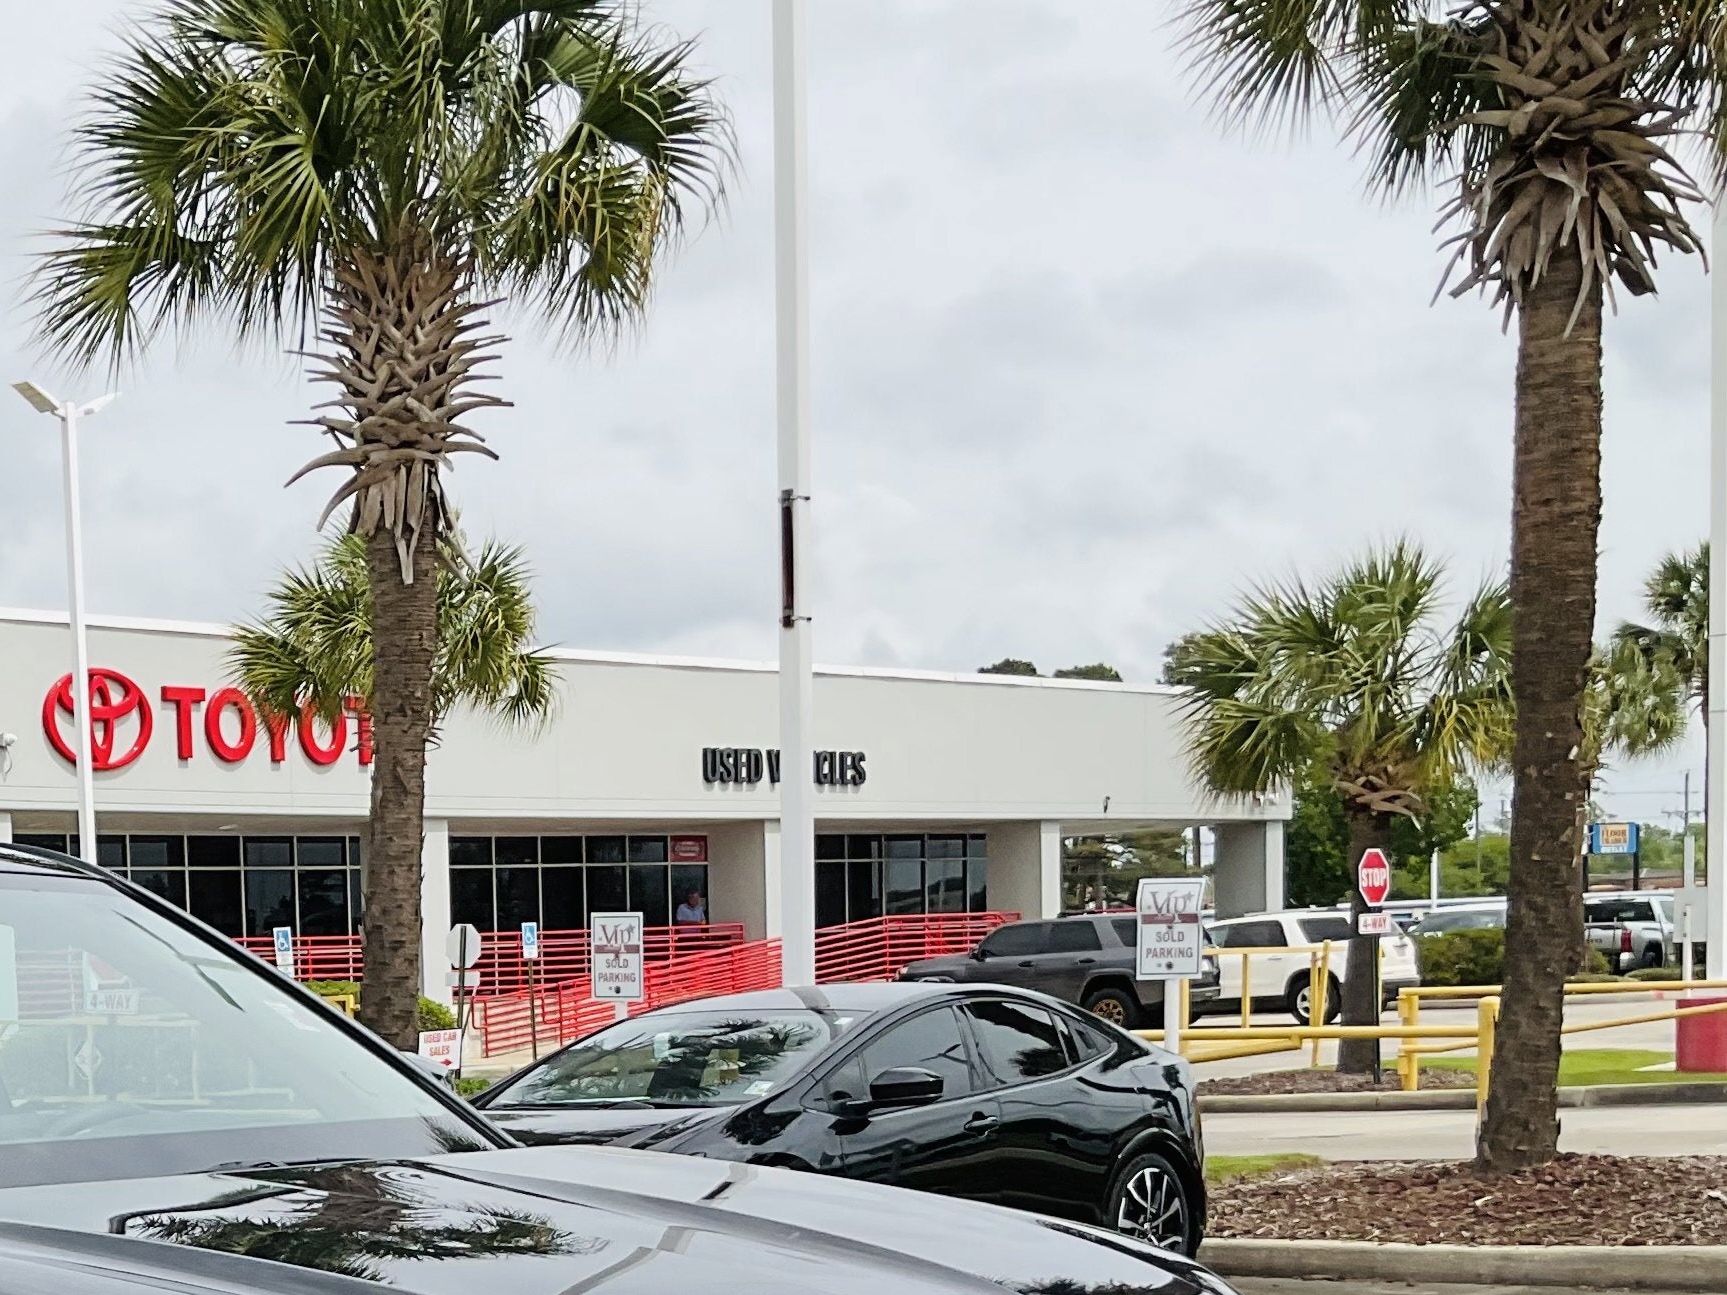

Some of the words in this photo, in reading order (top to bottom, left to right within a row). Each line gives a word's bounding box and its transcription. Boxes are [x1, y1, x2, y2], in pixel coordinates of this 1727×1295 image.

[702, 748, 763, 783] USED
[1361, 868, 1387, 887] STOP
[1362, 917, 1387, 929] 4-WAY
[1155, 931, 1185, 943] SOLD
[1145, 947, 1193, 959] PARKING
[605, 958, 629, 969] SOLD
[598, 972, 636, 983] PARKING
[88, 992, 131, 1010] 4-WAY
[429, 1045, 450, 1057] SALES
